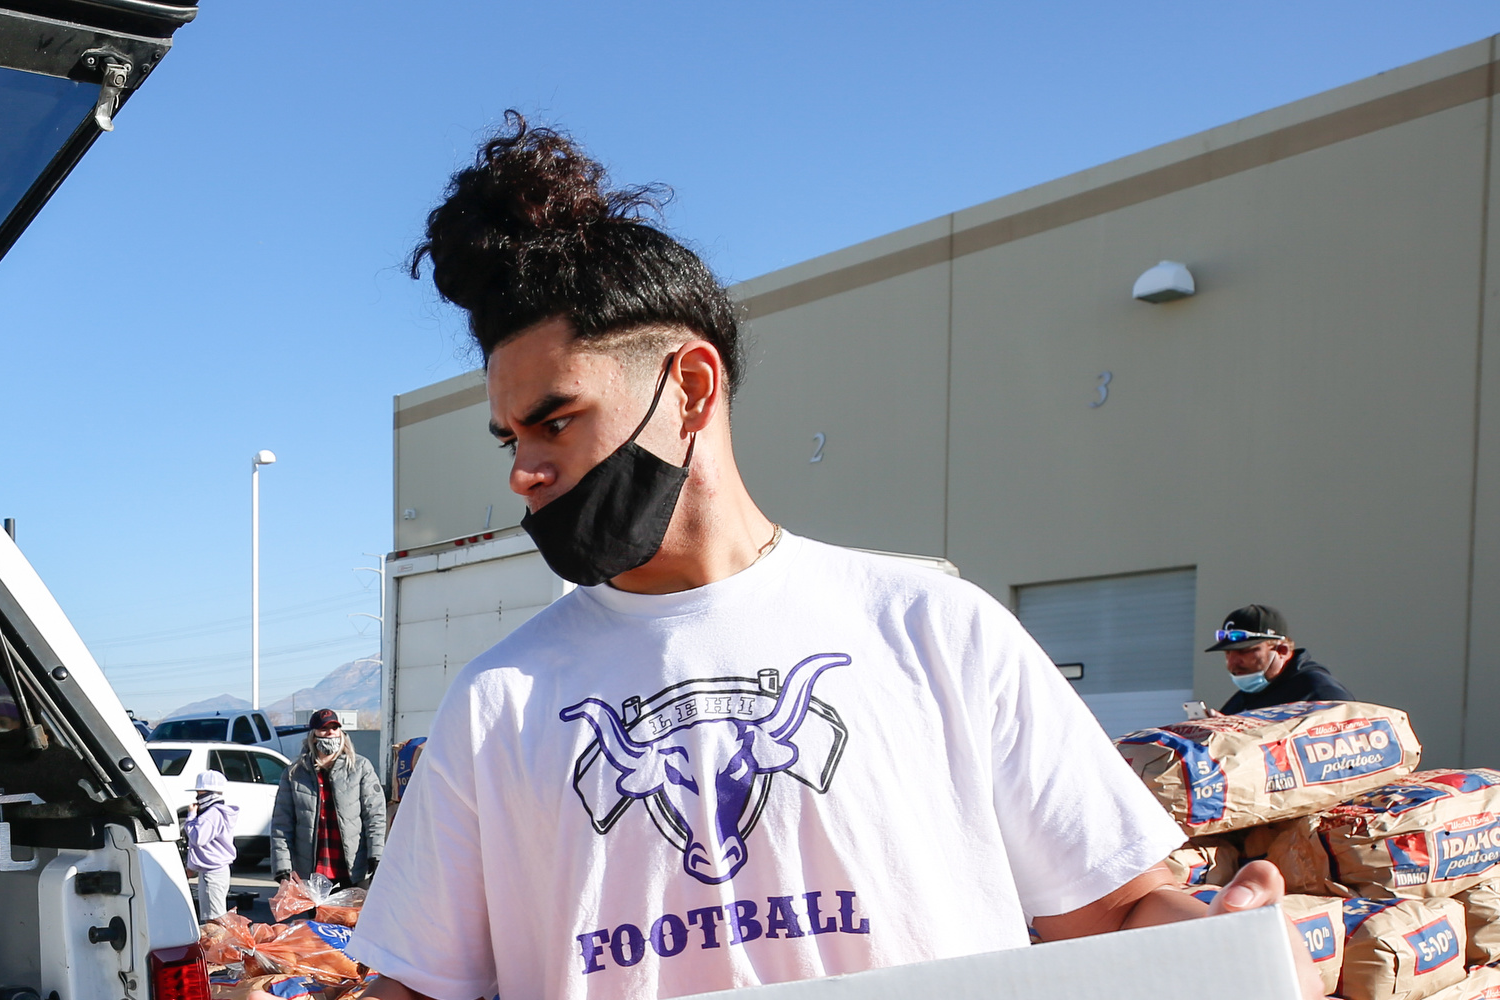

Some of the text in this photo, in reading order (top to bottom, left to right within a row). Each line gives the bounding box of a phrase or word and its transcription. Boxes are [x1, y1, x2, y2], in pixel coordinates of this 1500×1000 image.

[1087, 370, 1112, 408] 3
[810, 432, 826, 464] 2
[648, 695, 756, 736] LEHI
[1305, 730, 1390, 764] IDAHO
[1197, 760, 1210, 775] 5
[1321, 750, 1384, 780] potatoes
[1441, 826, 1500, 860] IDAHO
[1396, 872, 1427, 886] IDAHO
[1444, 850, 1499, 877] potatoes
[576, 890, 870, 975] FOOTBALL
[1303, 926, 1330, 953] -10lb
